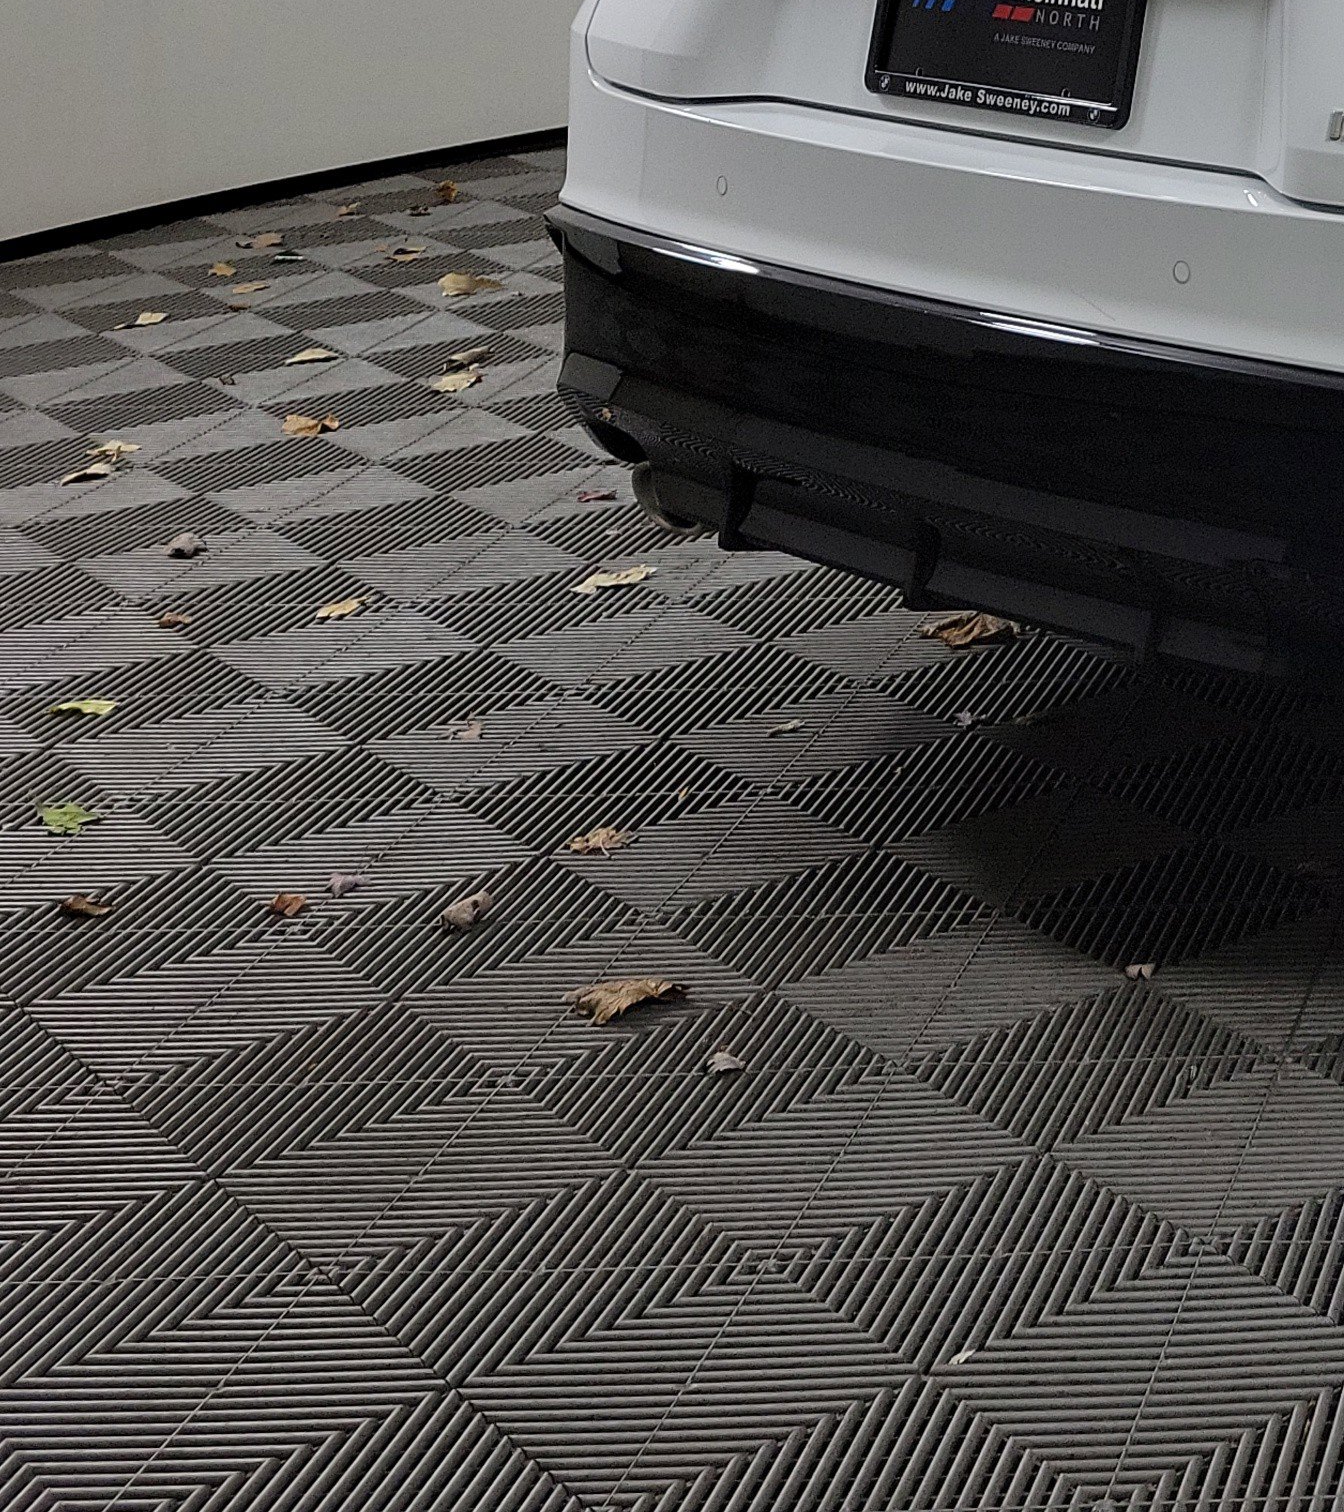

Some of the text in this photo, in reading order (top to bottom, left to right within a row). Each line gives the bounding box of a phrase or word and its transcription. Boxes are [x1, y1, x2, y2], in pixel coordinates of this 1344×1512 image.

[1035, 9, 1101, 31] NORTH
[993, 32, 1096, 54] A JAKE SWEENEY COMPANY
[905, 80, 1071, 116] www.Jake Sweeney.com
